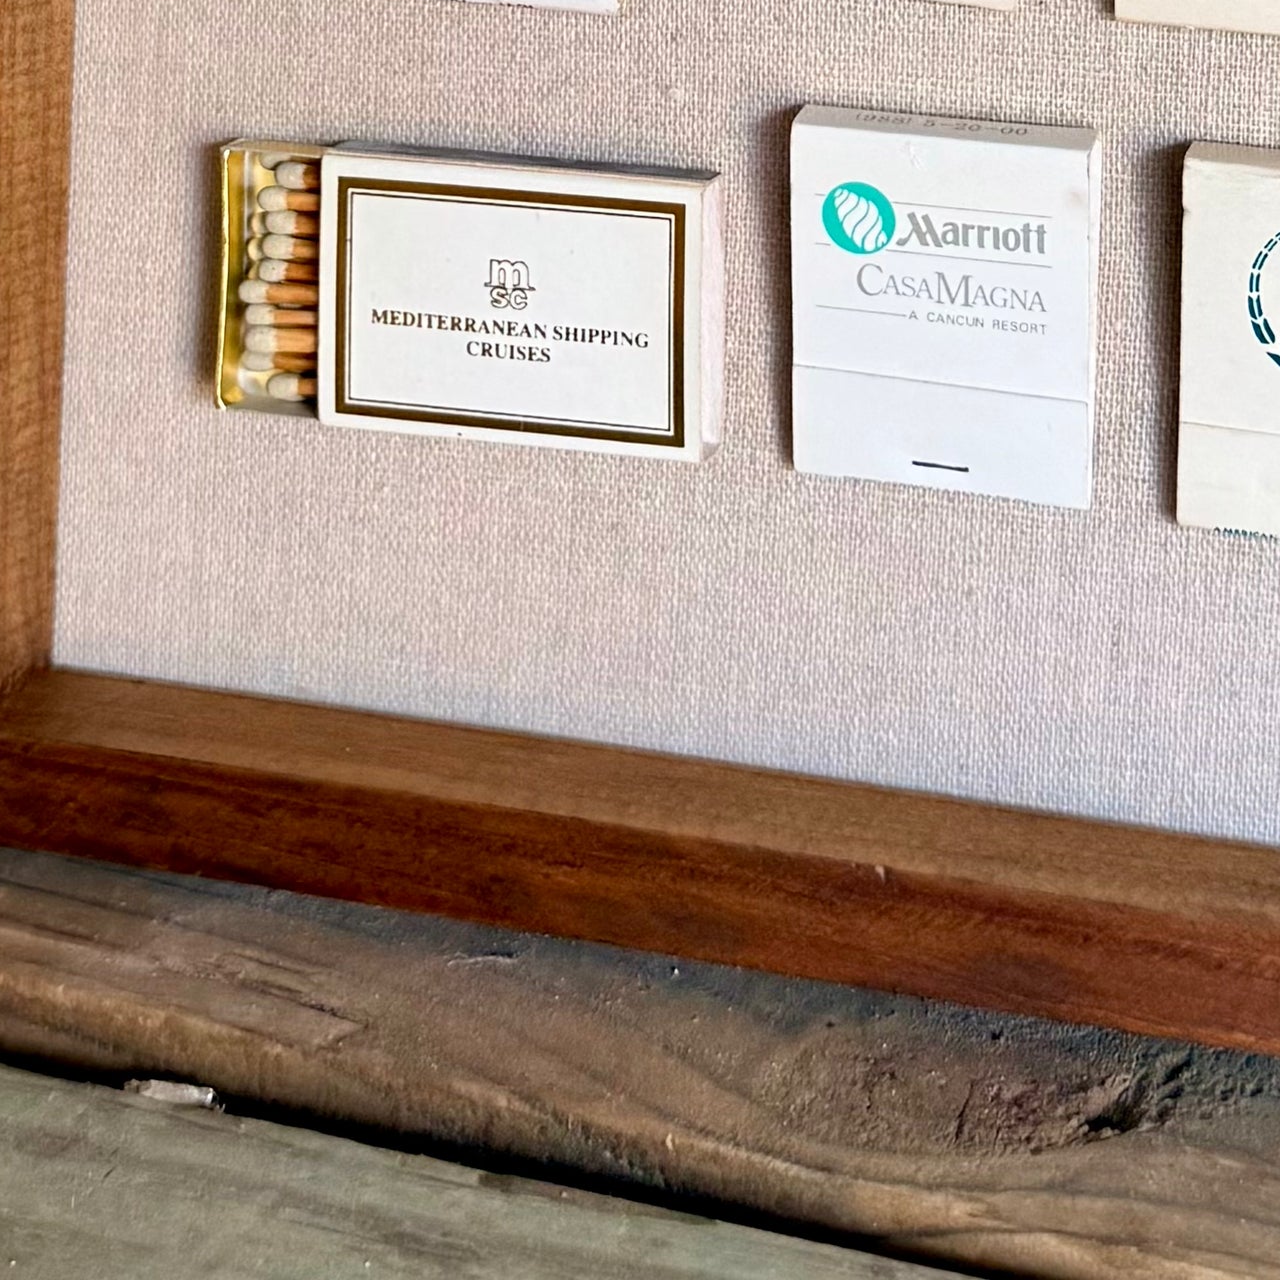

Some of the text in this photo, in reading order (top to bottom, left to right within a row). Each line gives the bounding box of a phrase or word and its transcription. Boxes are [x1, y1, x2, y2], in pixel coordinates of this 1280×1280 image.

[897, 212, 1046, 254] Marriott
[371, 309, 648, 348] MEDITERRANEAN SHIPPING
[909, 311, 1046, 335] A CANCUN RESORT
[467, 341, 550, 362] CRUISES
